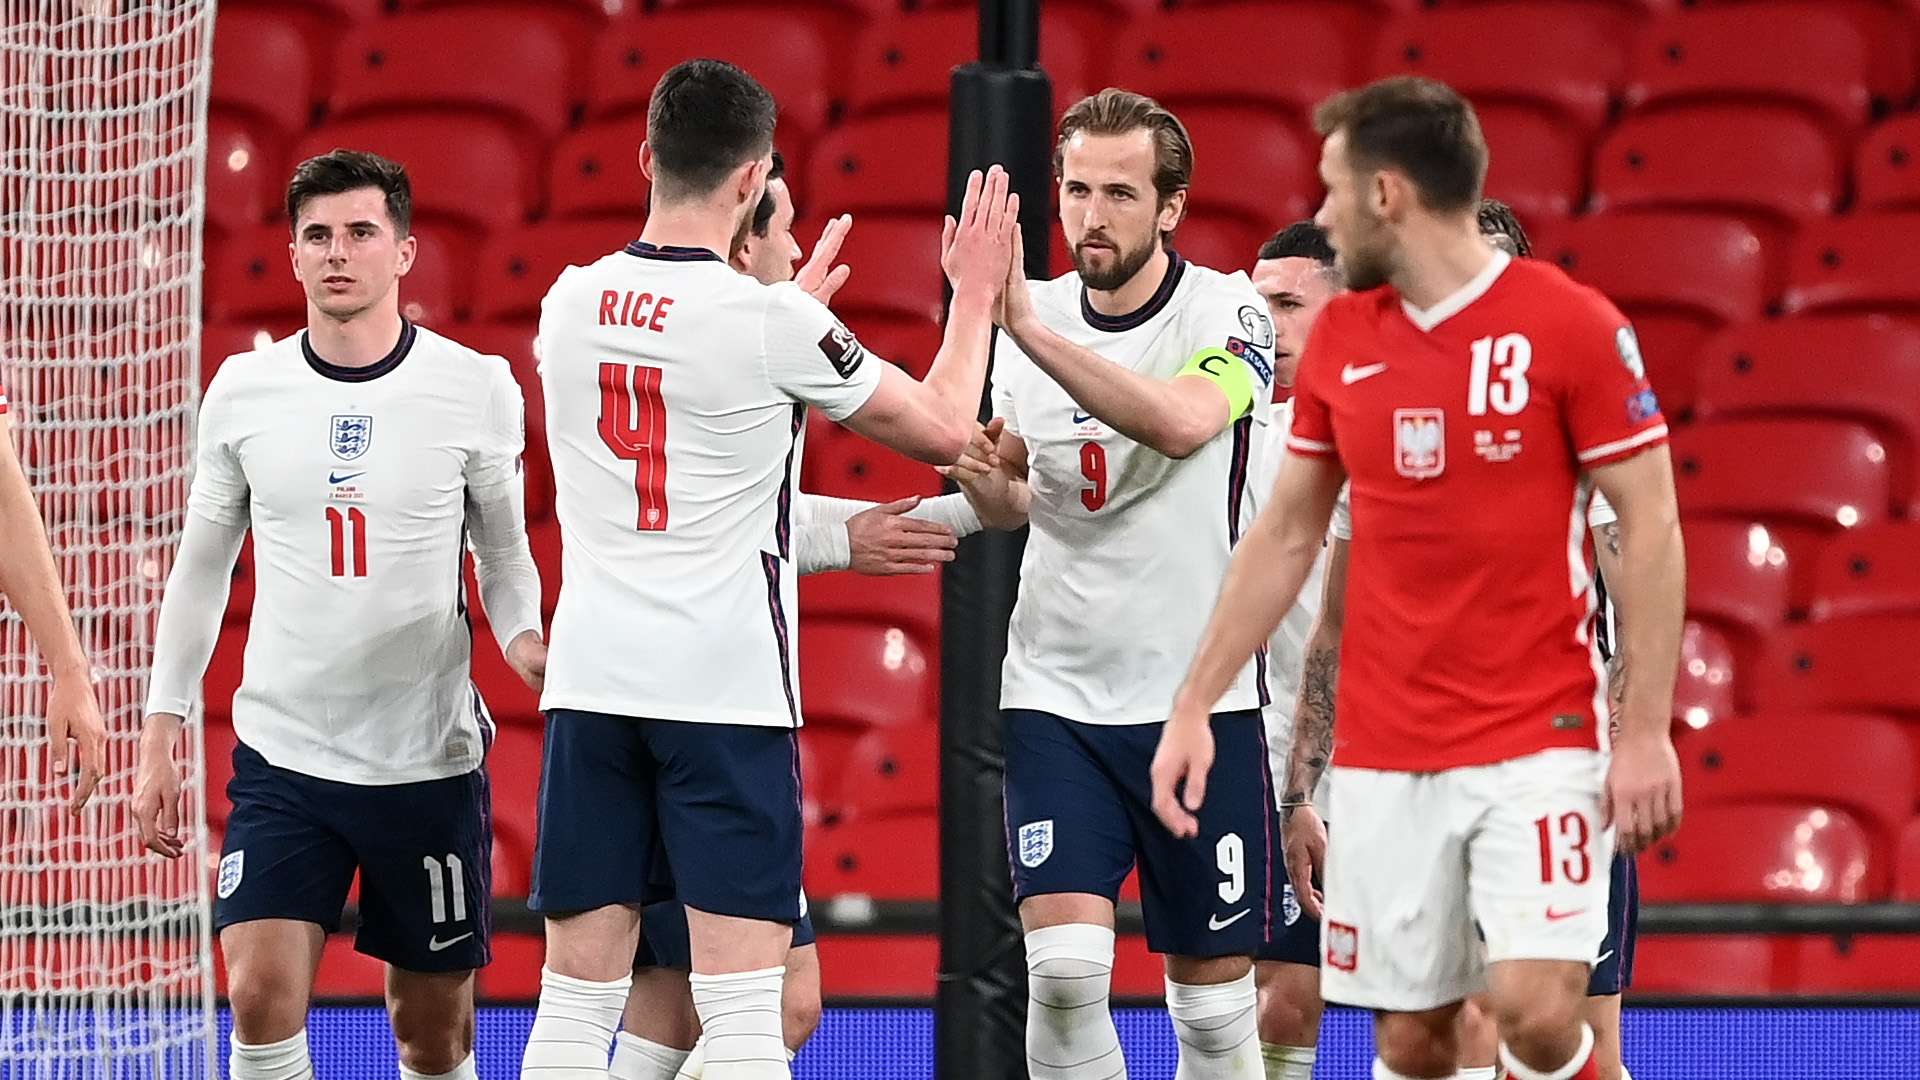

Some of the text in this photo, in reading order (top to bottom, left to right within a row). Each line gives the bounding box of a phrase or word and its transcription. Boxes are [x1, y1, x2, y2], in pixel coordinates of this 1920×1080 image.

[599, 290, 674, 333] RICE
[1198, 355, 1230, 377] C
[1467, 332, 1532, 416] 13
[597, 361, 667, 531] 4
[1079, 441, 1107, 512] 9
[325, 506, 367, 577] 11
[1215, 832, 1246, 903] 9
[1534, 811, 1592, 885] 13
[423, 853, 467, 924] 11
